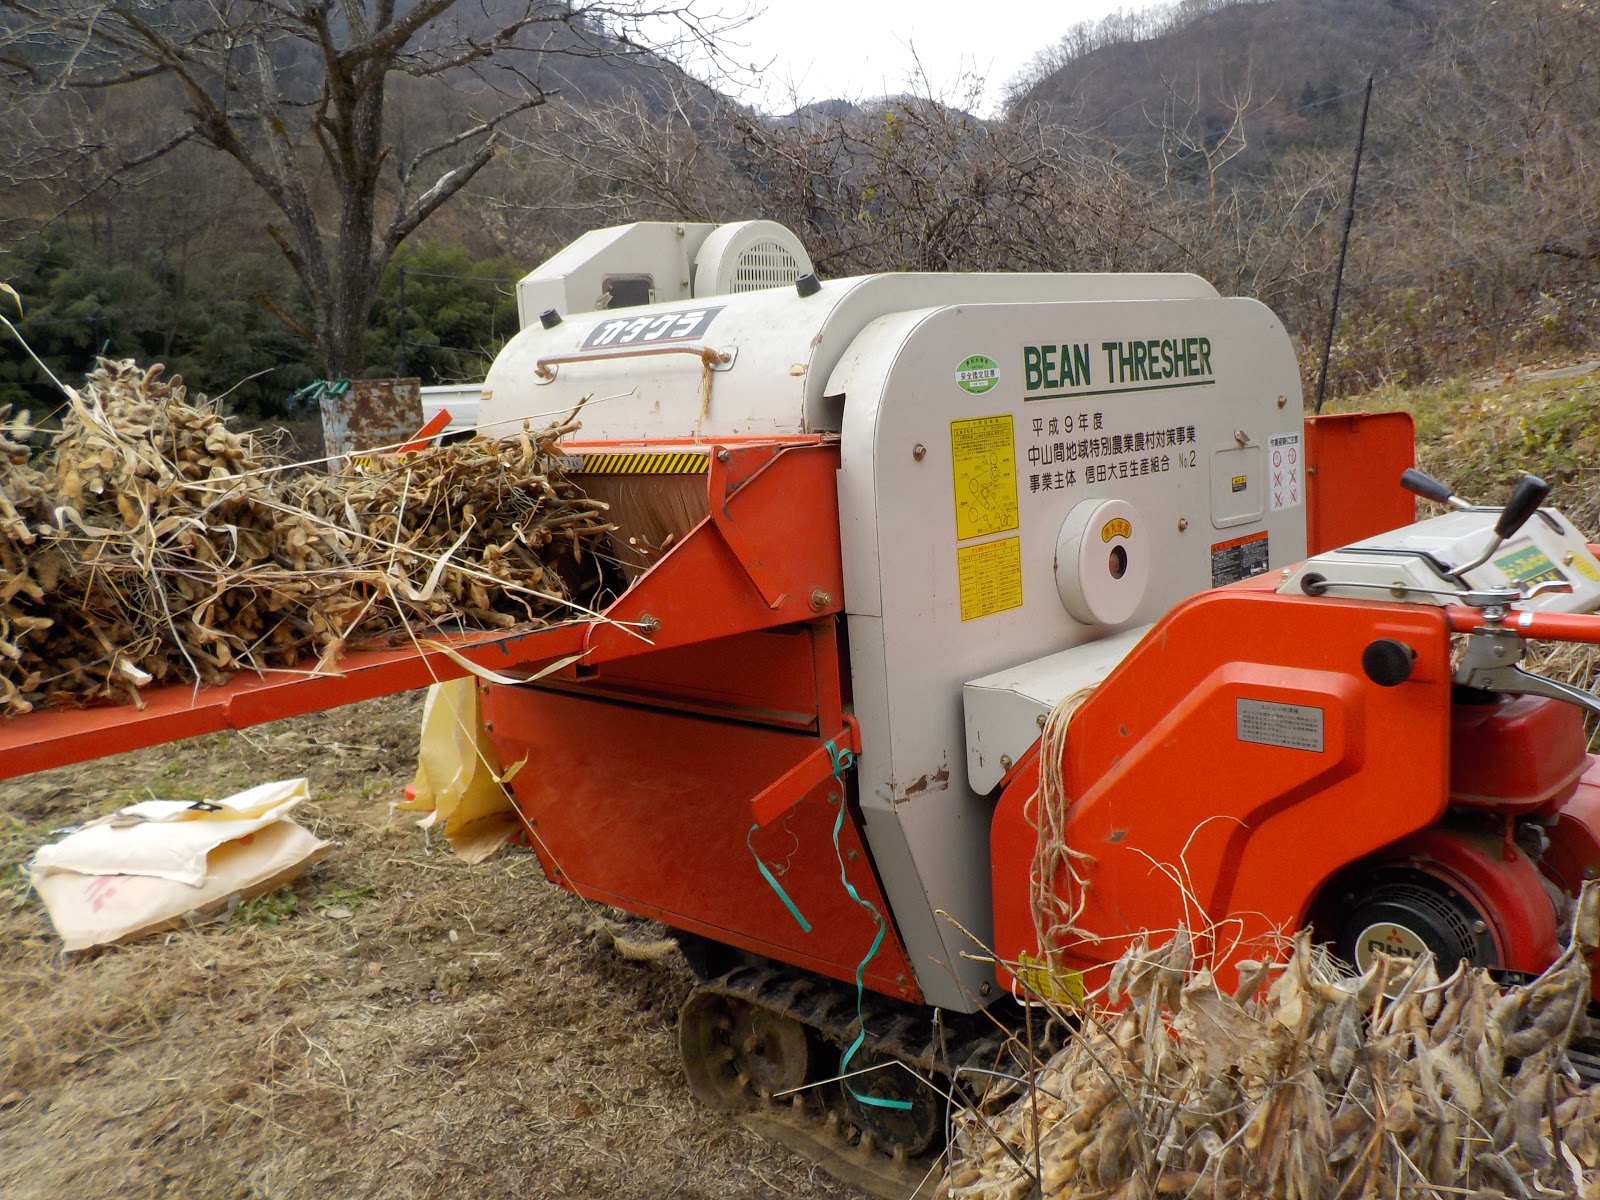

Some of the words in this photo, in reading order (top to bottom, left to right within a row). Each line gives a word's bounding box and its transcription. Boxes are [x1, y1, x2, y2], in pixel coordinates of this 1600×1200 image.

[592, 310, 707, 346] カタクラ
[1023, 343, 1091, 391] BEAN
[1101, 337, 1213, 384] THRESHER
[1027, 425, 1197, 467] 中山間地域特別農業農村対策事業
[1029, 468, 1077, 494] 事業主体
[1085, 454, 1170, 485] 信田大豆生産組合
